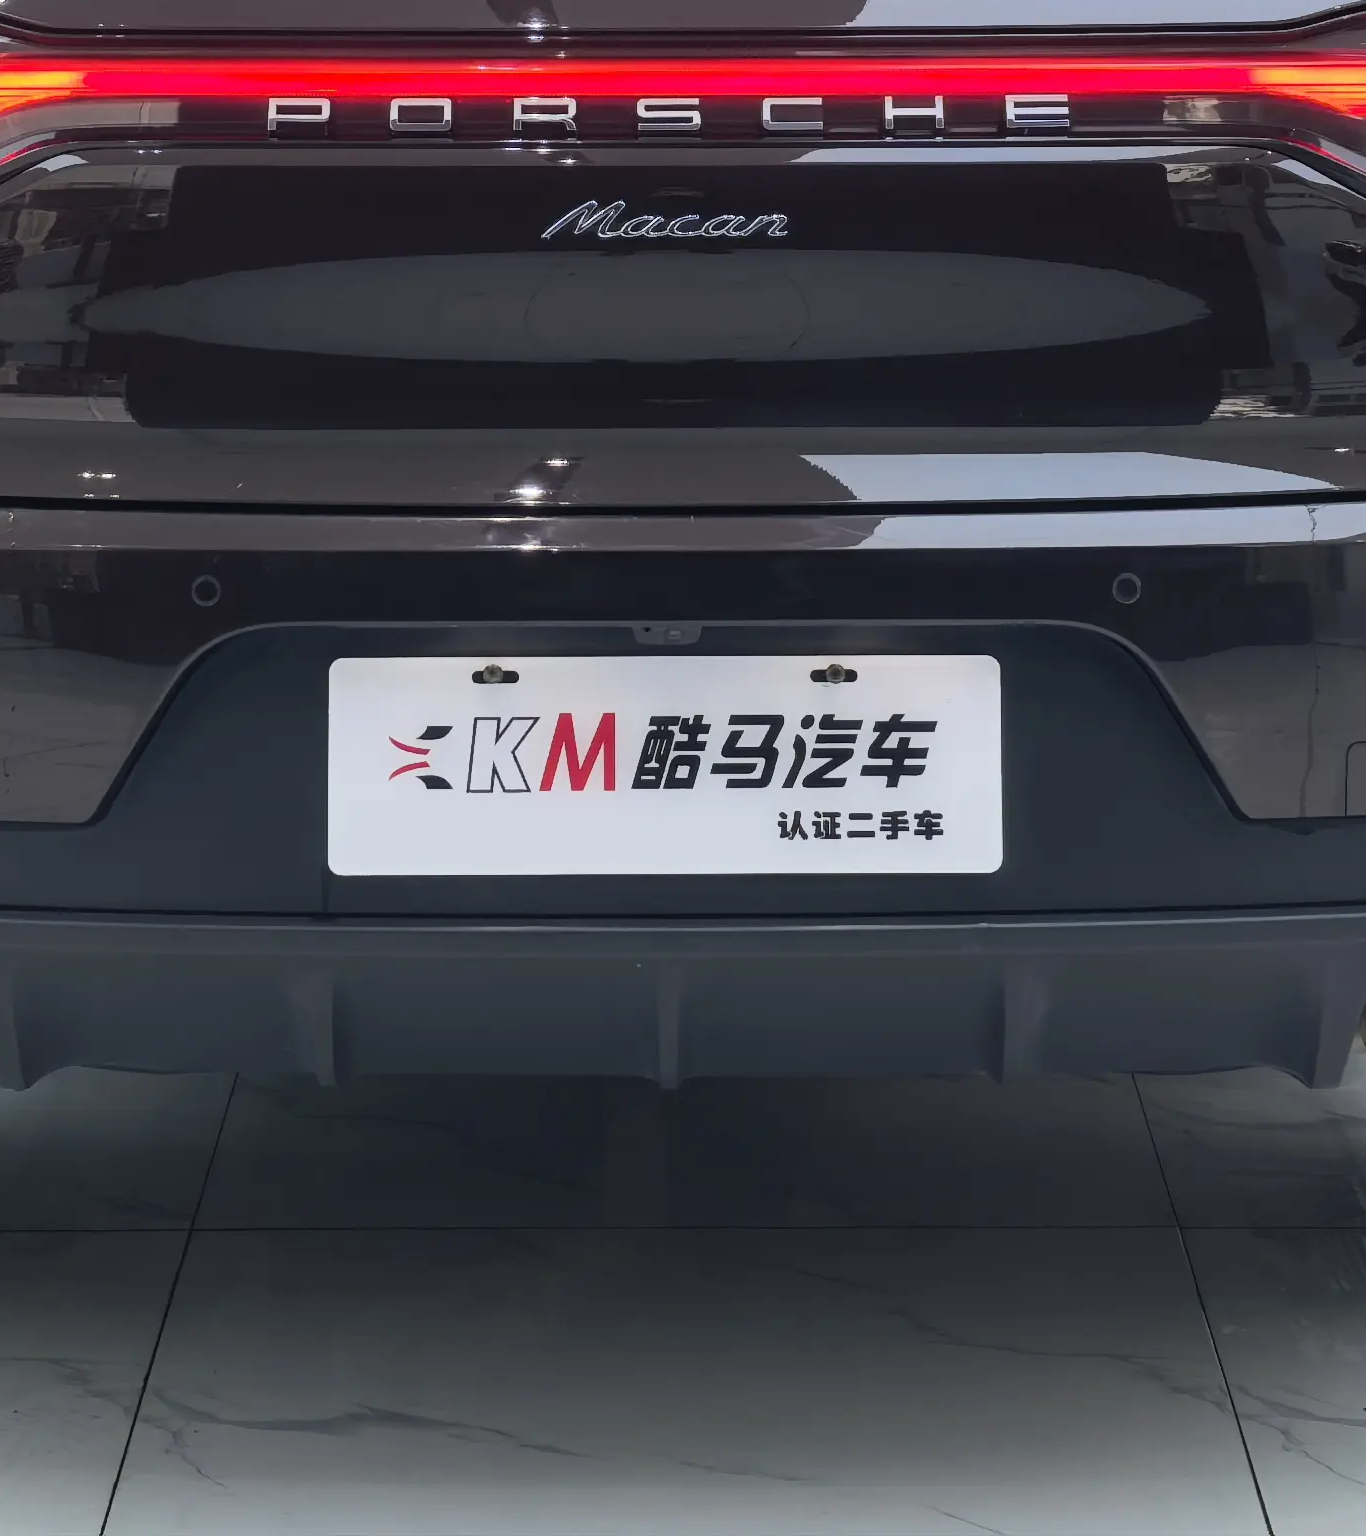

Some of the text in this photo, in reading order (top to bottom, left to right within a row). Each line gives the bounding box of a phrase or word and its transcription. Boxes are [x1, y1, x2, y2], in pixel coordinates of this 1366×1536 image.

[267, 94, 1070, 131] PORSCHE
[540, 199, 788, 239] Macan
[465, 711, 938, 794] KM 酷马汽车
[777, 809, 945, 841] 认证二手车
